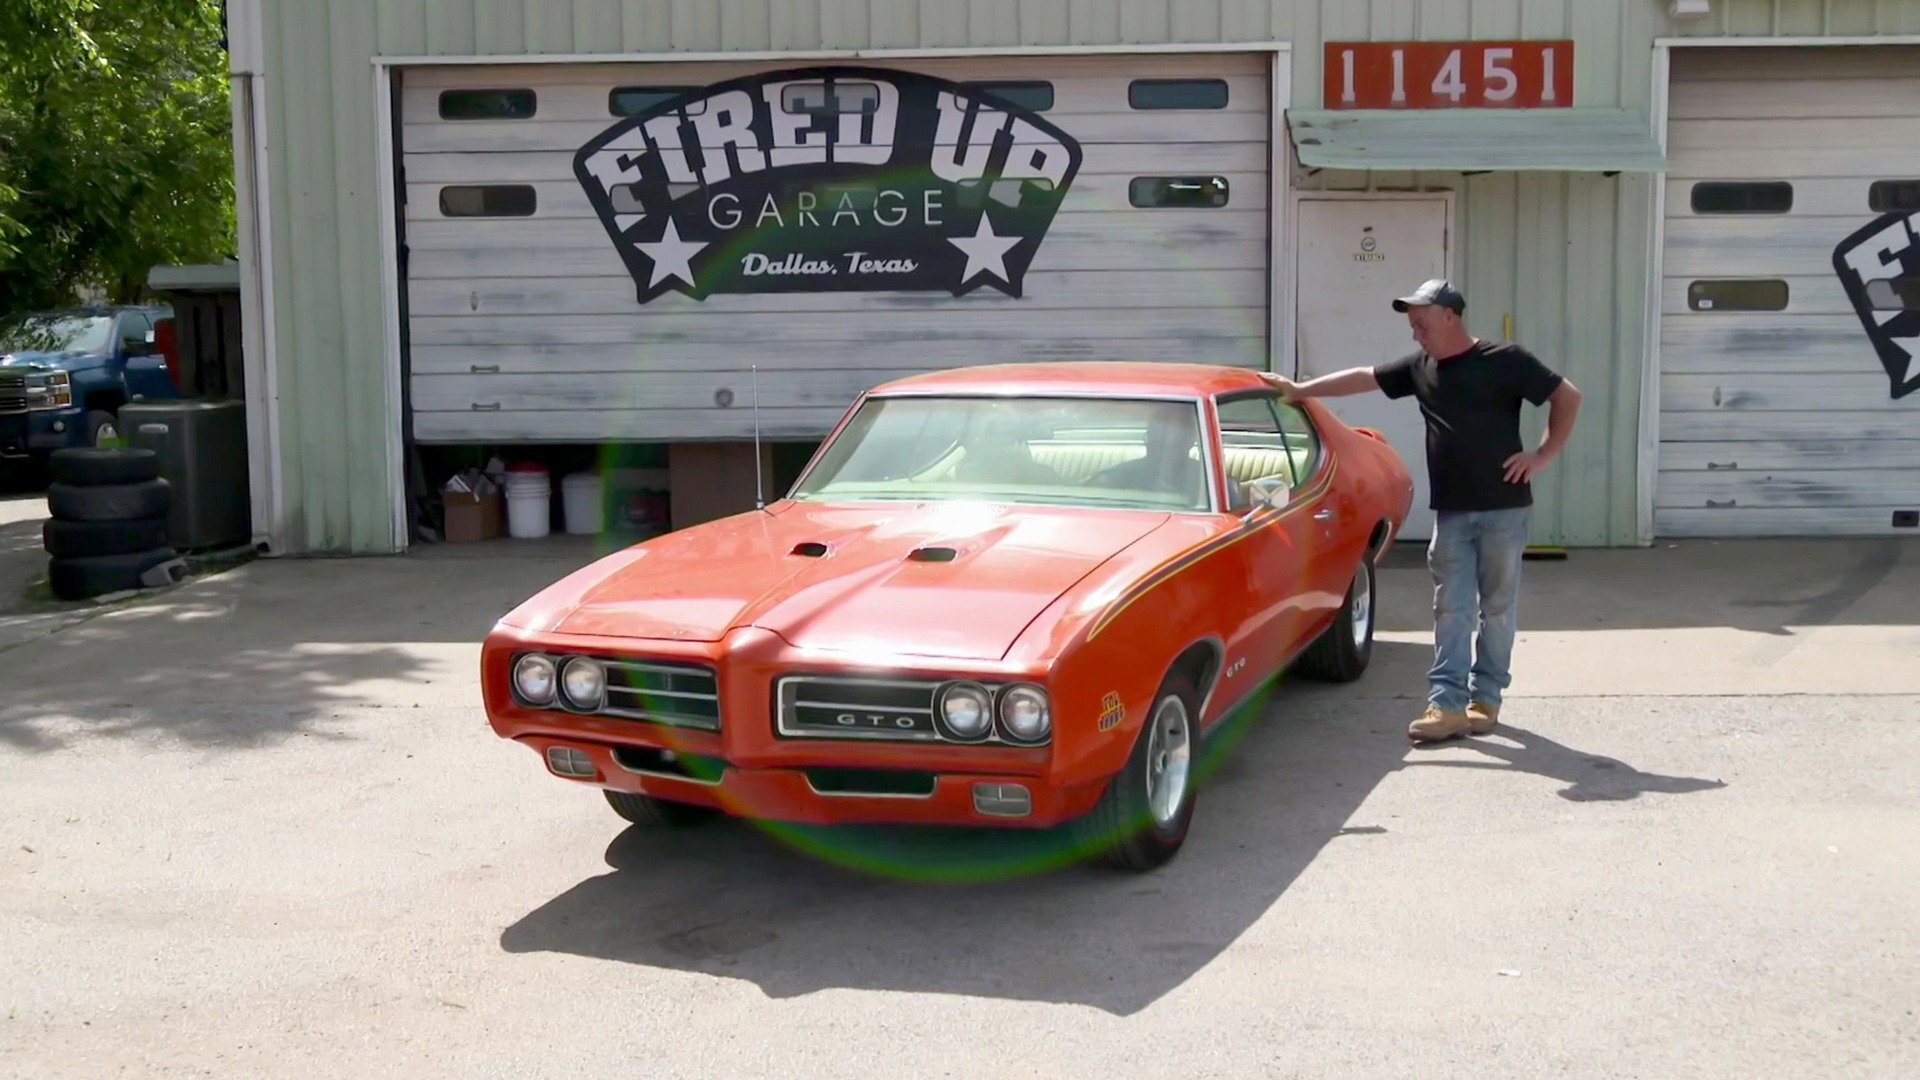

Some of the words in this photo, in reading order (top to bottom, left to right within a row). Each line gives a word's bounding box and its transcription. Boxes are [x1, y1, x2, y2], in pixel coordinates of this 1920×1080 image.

[1341, 48, 1556, 102] 11451
[584, 78, 899, 233] FIRED
[931, 91, 1071, 208] UP
[708, 190, 943, 230] GARAGE
[844, 251, 919, 273] Texas
[1226, 657, 1245, 678] GTO
[837, 713, 915, 728] GTO
